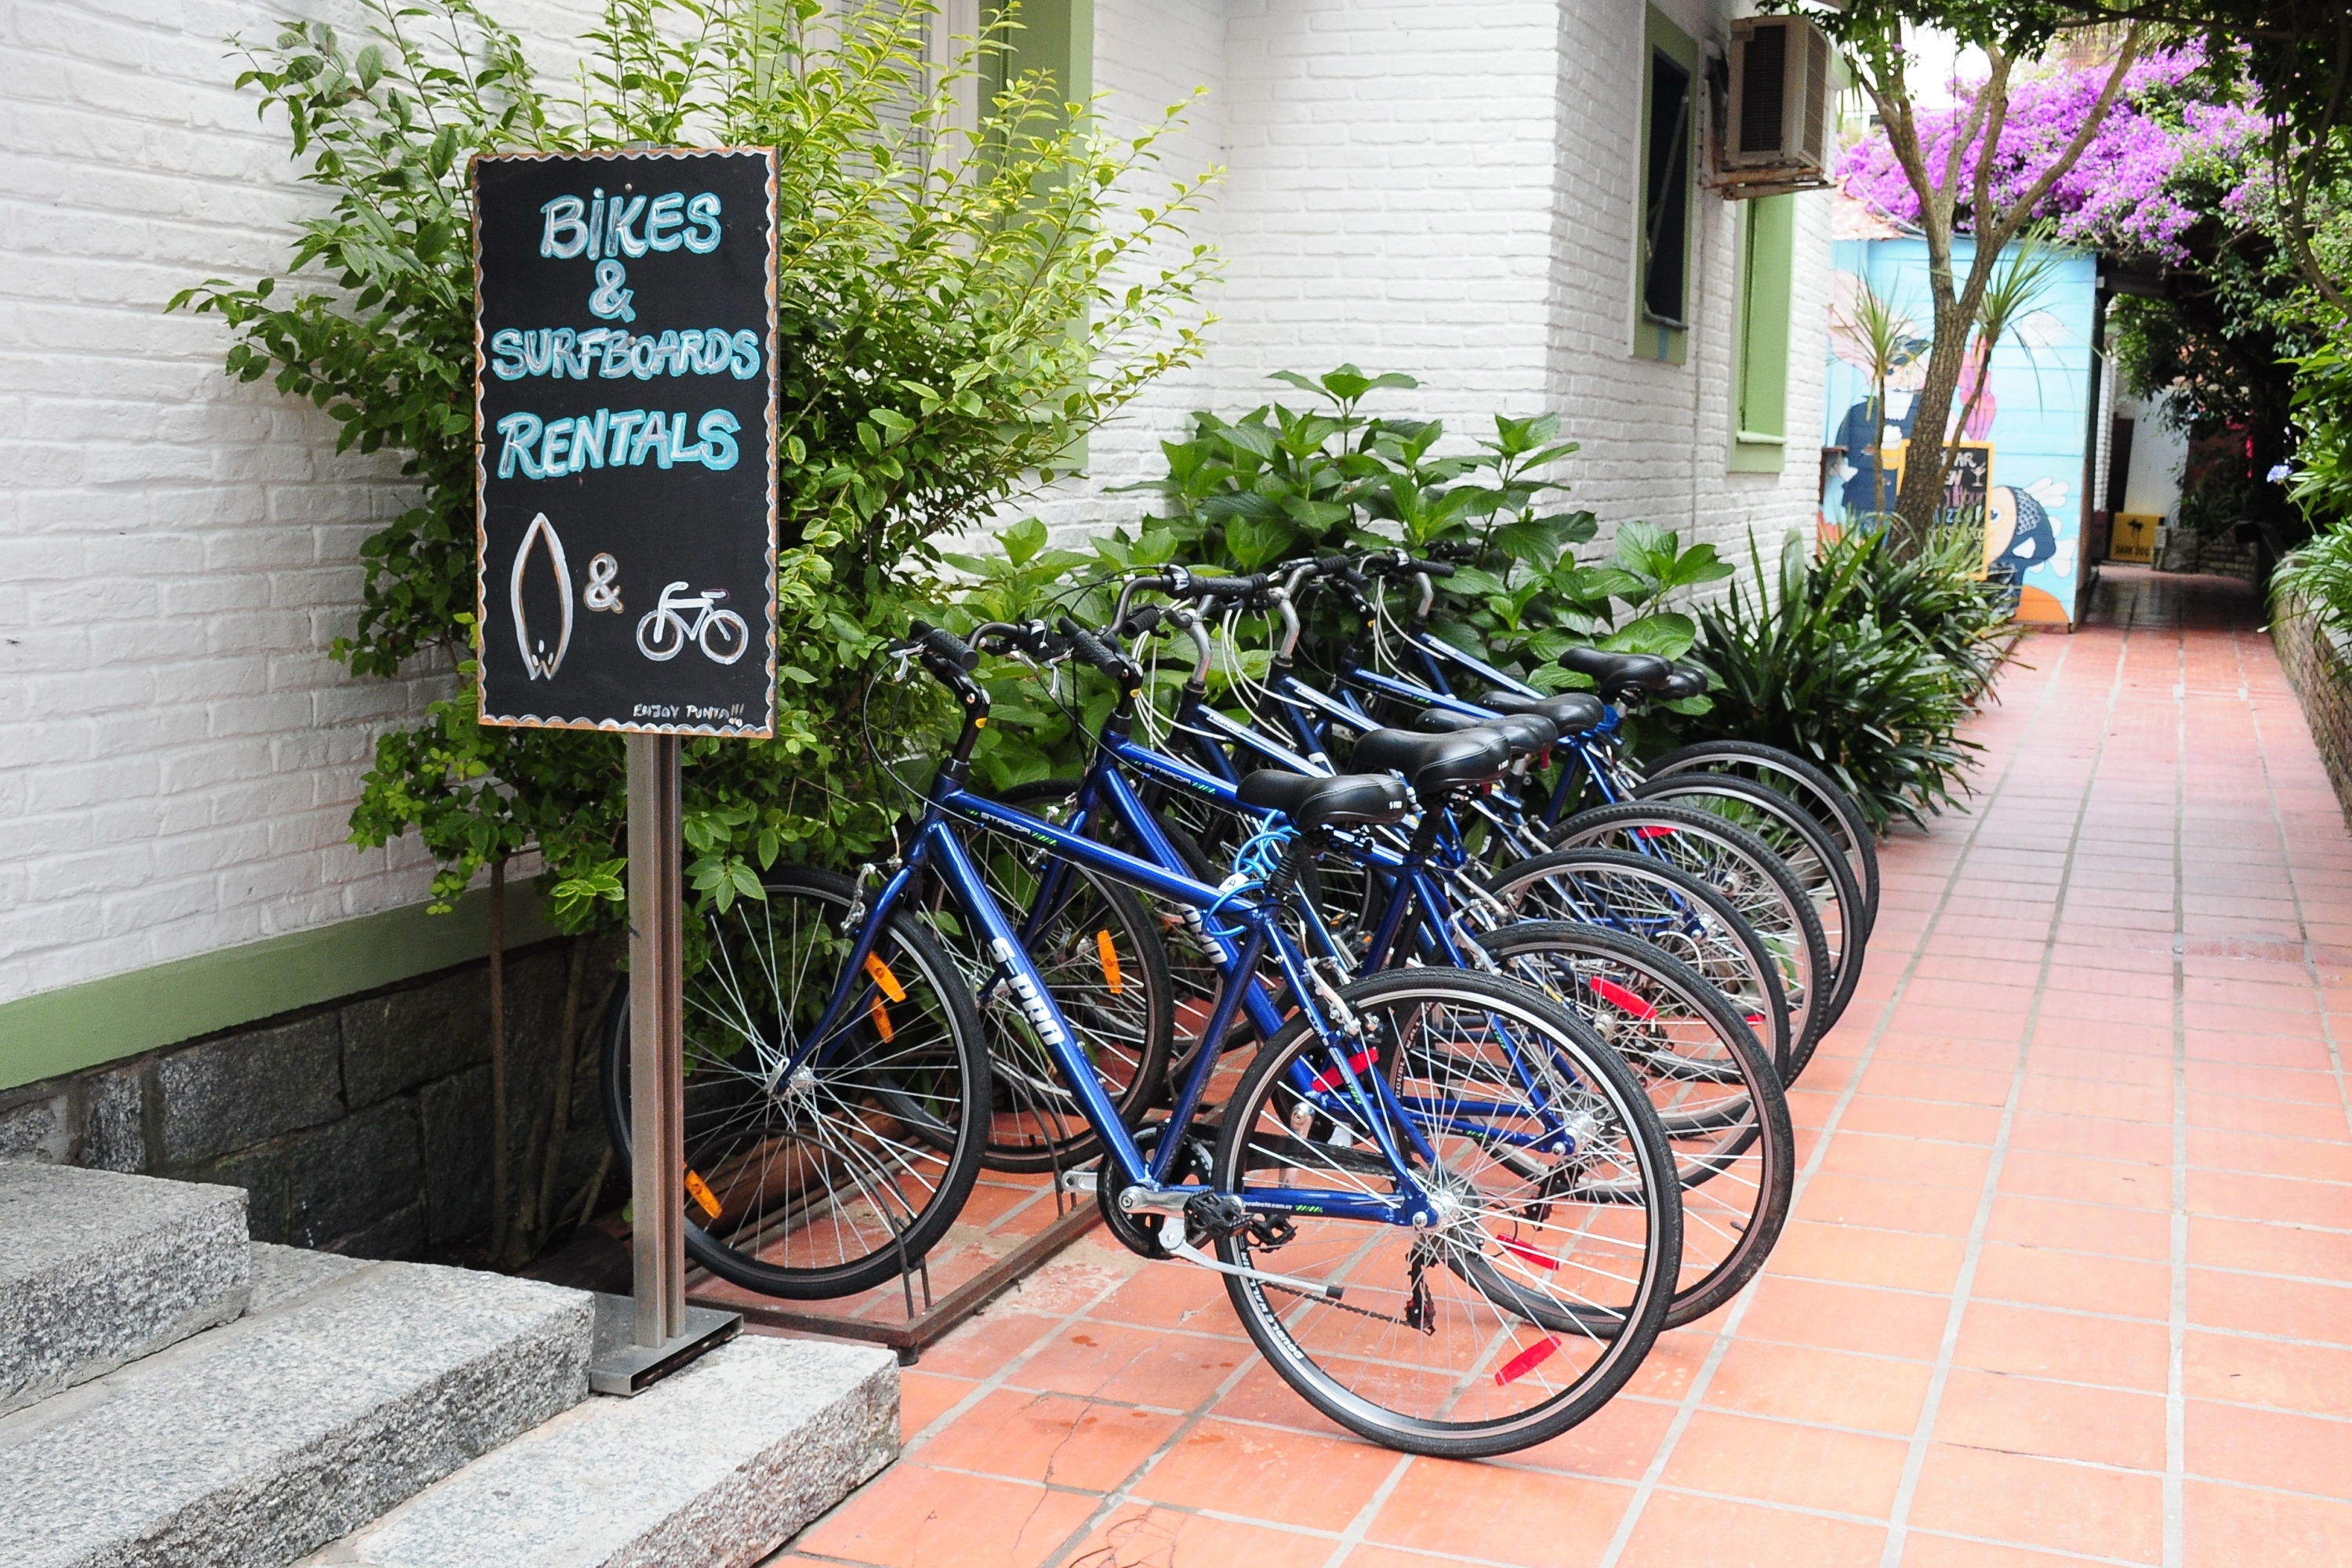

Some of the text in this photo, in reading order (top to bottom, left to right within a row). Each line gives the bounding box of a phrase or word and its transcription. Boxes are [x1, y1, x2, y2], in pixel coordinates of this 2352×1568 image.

[589, 259, 637, 322] &
[492, 328, 760, 380] SURFBOARDS
[497, 408, 742, 480] RENTALS
[583, 553, 624, 614] &
[633, 703, 680, 719] ENJOY
[1144, 762, 1192, 785] STRADA
[980, 811, 1031, 835] STRADA
[988, 937, 1065, 1046] S-PRO
[1265, 1314, 1305, 1360] DOUBLE
